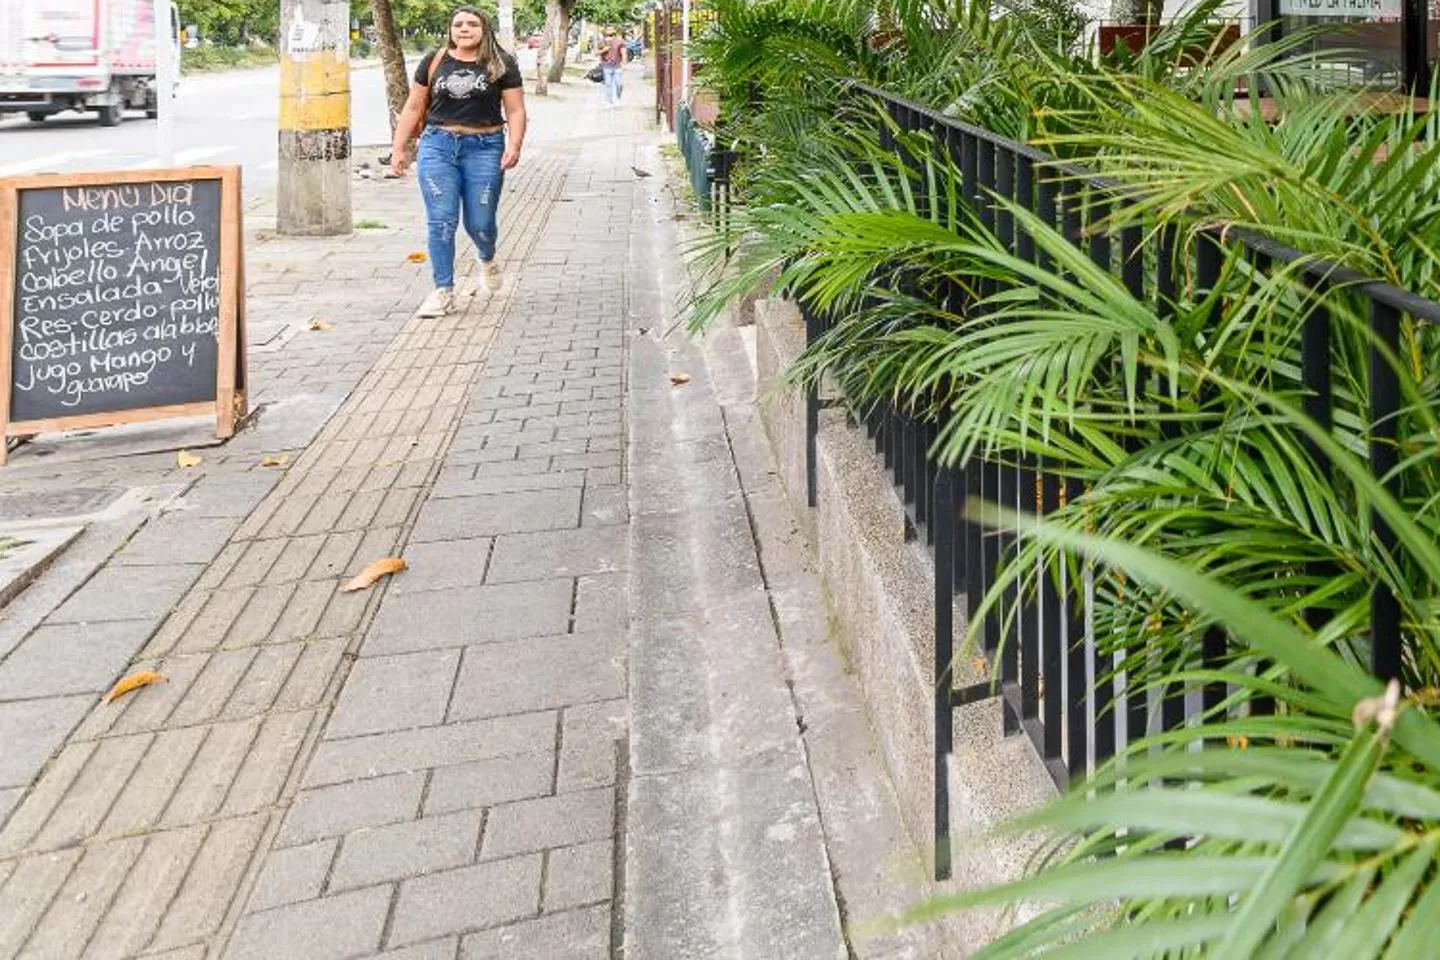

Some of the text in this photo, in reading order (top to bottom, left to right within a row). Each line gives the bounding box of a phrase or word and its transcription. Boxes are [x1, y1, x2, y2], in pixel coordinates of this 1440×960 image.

[24, 205, 195, 246] Sopa de pollo
[22, 274, 162, 312] Ensalada
[89, 346, 171, 375] Mango
